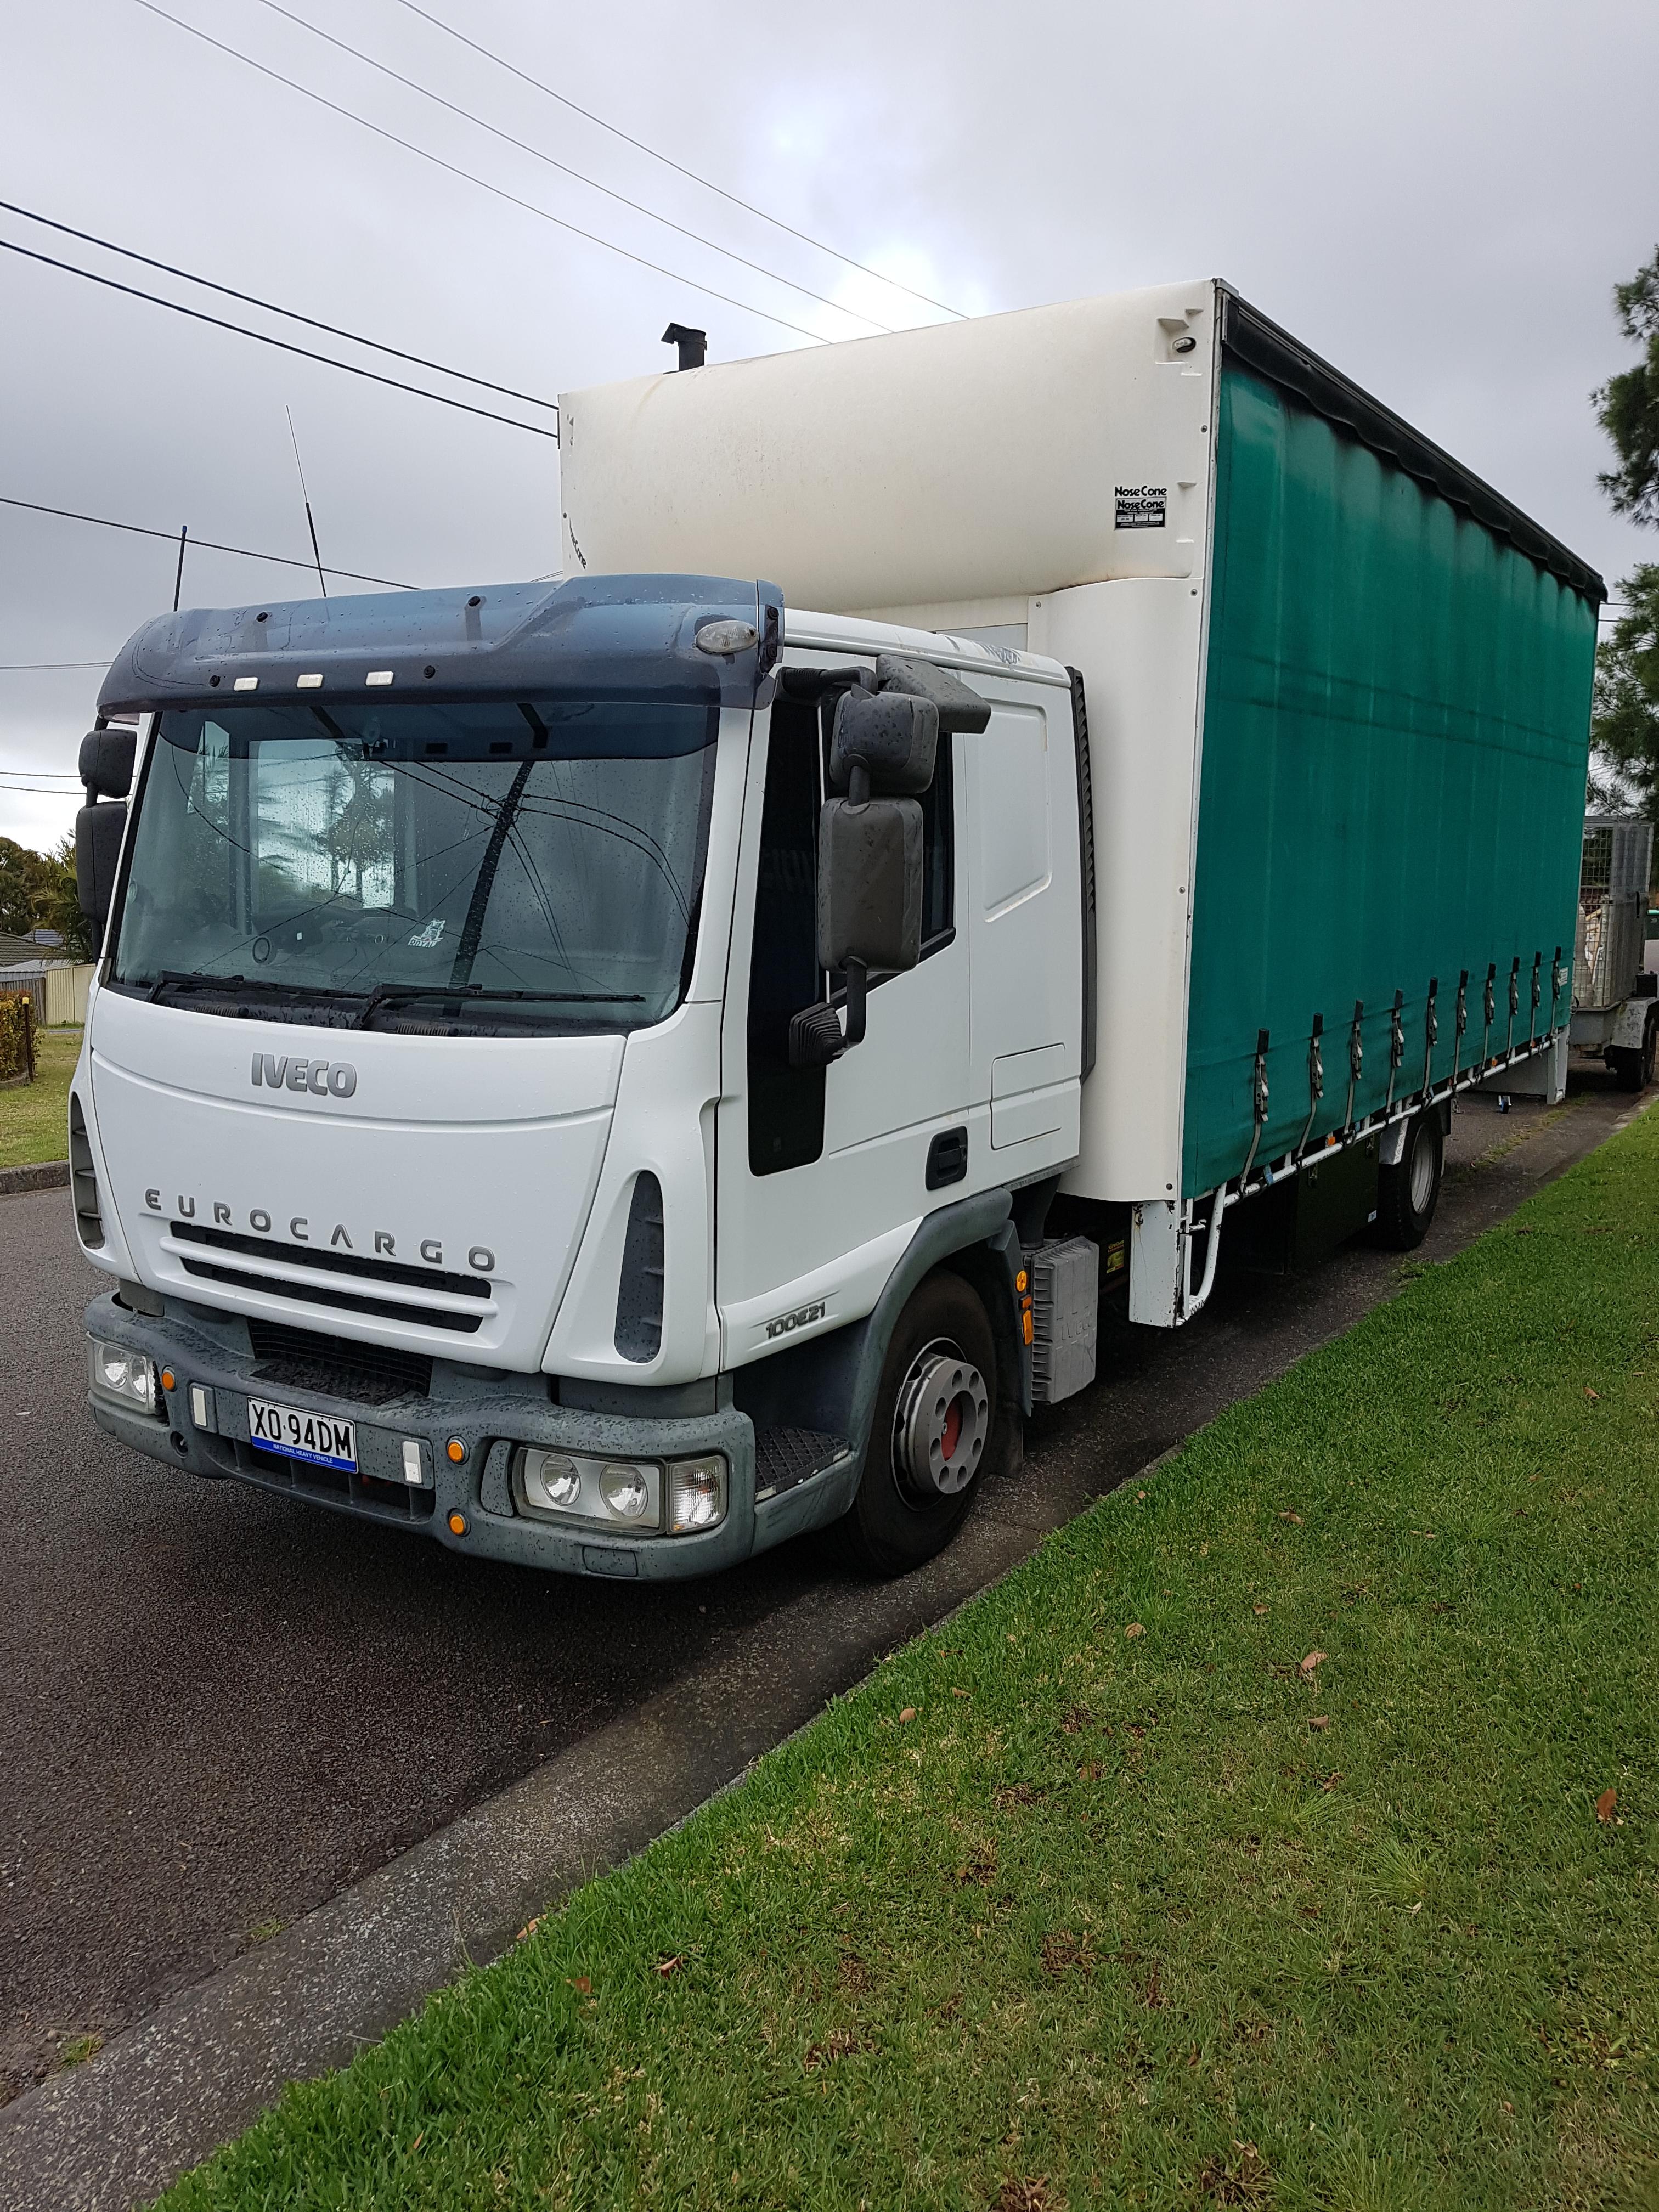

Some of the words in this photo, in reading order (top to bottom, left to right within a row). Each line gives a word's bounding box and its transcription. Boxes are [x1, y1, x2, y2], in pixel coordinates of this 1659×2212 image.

[251, 1052, 357, 1098] IVECO
[144, 1188, 496, 1272] EUROCARGO
[765, 1301, 826, 1339] 100E21
[273, 1443, 296, 1454] NATIONAL
[296, 1450, 312, 1458] HEAVY
[313, 1454, 334, 1464] VEHICLE
